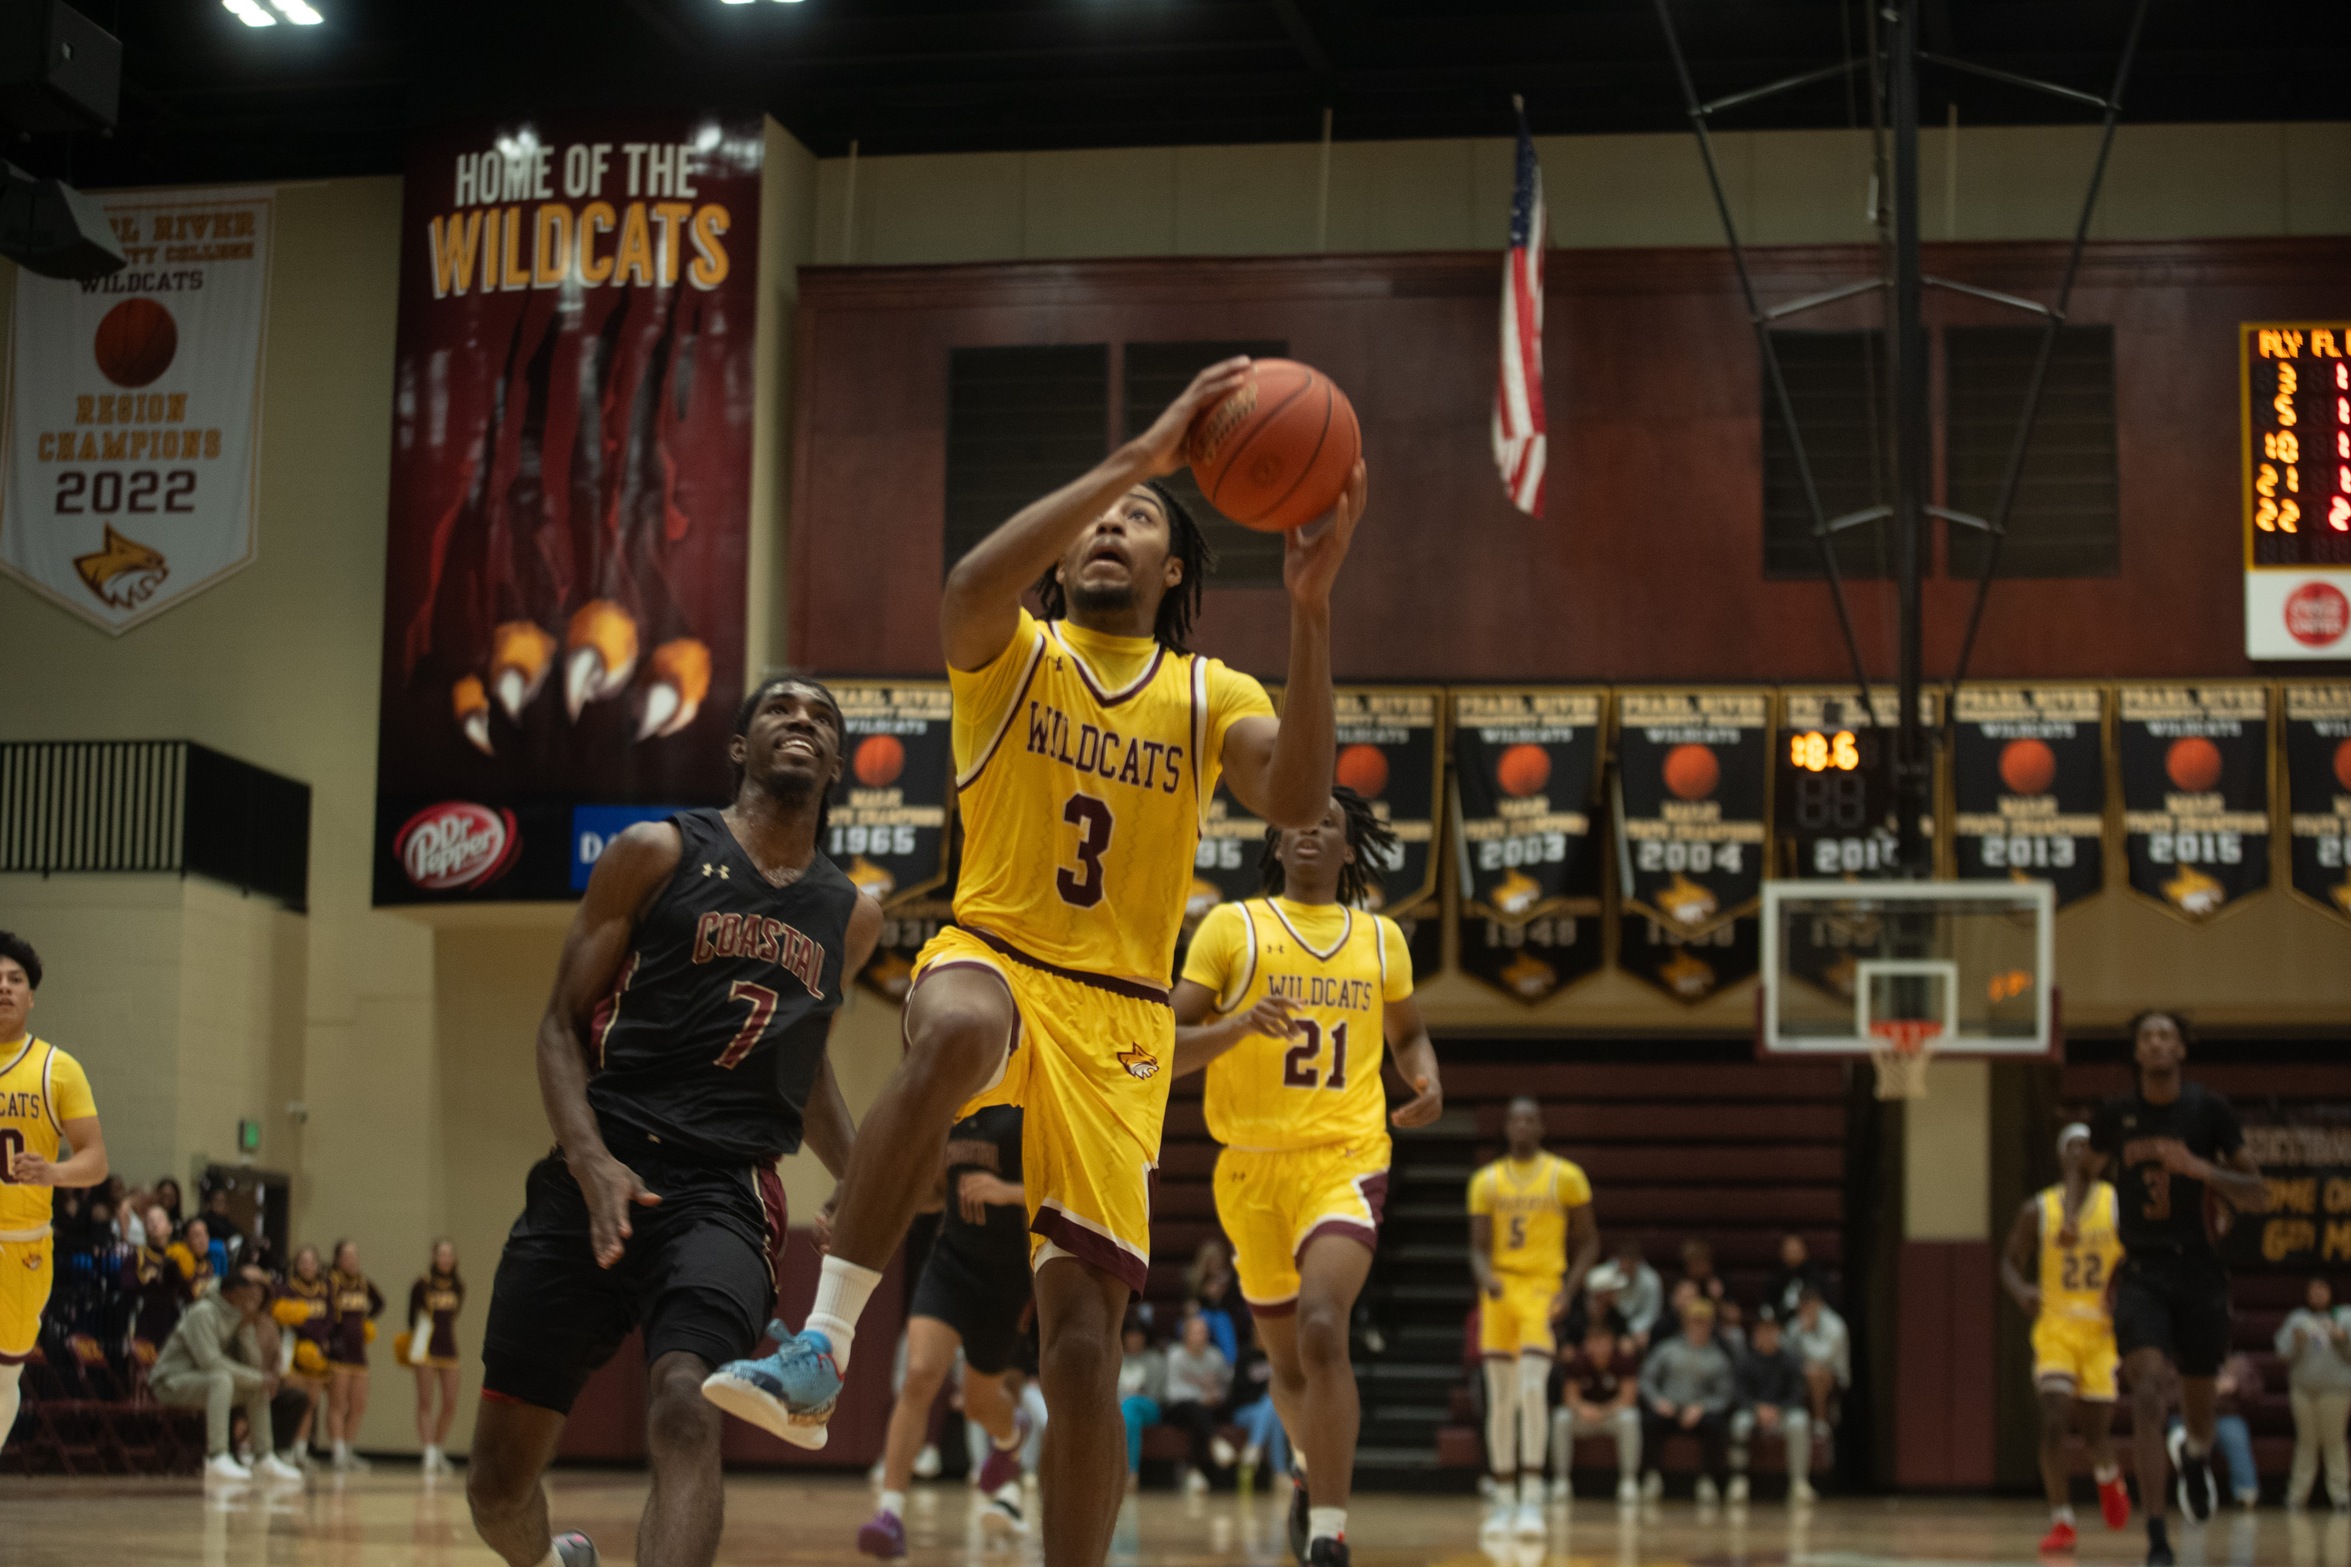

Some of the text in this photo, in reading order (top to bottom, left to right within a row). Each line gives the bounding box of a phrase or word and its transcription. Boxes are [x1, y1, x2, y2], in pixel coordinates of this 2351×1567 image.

[455, 142, 700, 207] HOME OF THE
[427, 201, 732, 299] WILDCATS
[80, 271, 203, 294] WILDCATS
[76, 393, 188, 425] REGION
[38, 428, 222, 463] CHAMPIONS
[55, 469, 197, 515] 2022
[1027, 701, 1183, 794] WILDCATS
[440, 814, 474, 843] Dr
[829, 827, 915, 856] 1965
[414, 823, 498, 881] Pepper
[1057, 792, 1115, 910] 3
[1478, 832, 1566, 871] 2003
[1637, 841, 1743, 873] 2004
[1980, 835, 2076, 868] 2013
[691, 911, 825, 1001] COASTAL
[1268, 975, 1373, 1011] WILDCATS
[713, 979, 779, 1070] 7
[1283, 1018, 1348, 1090] 21
[2062, 1253, 2102, 1290] 22
